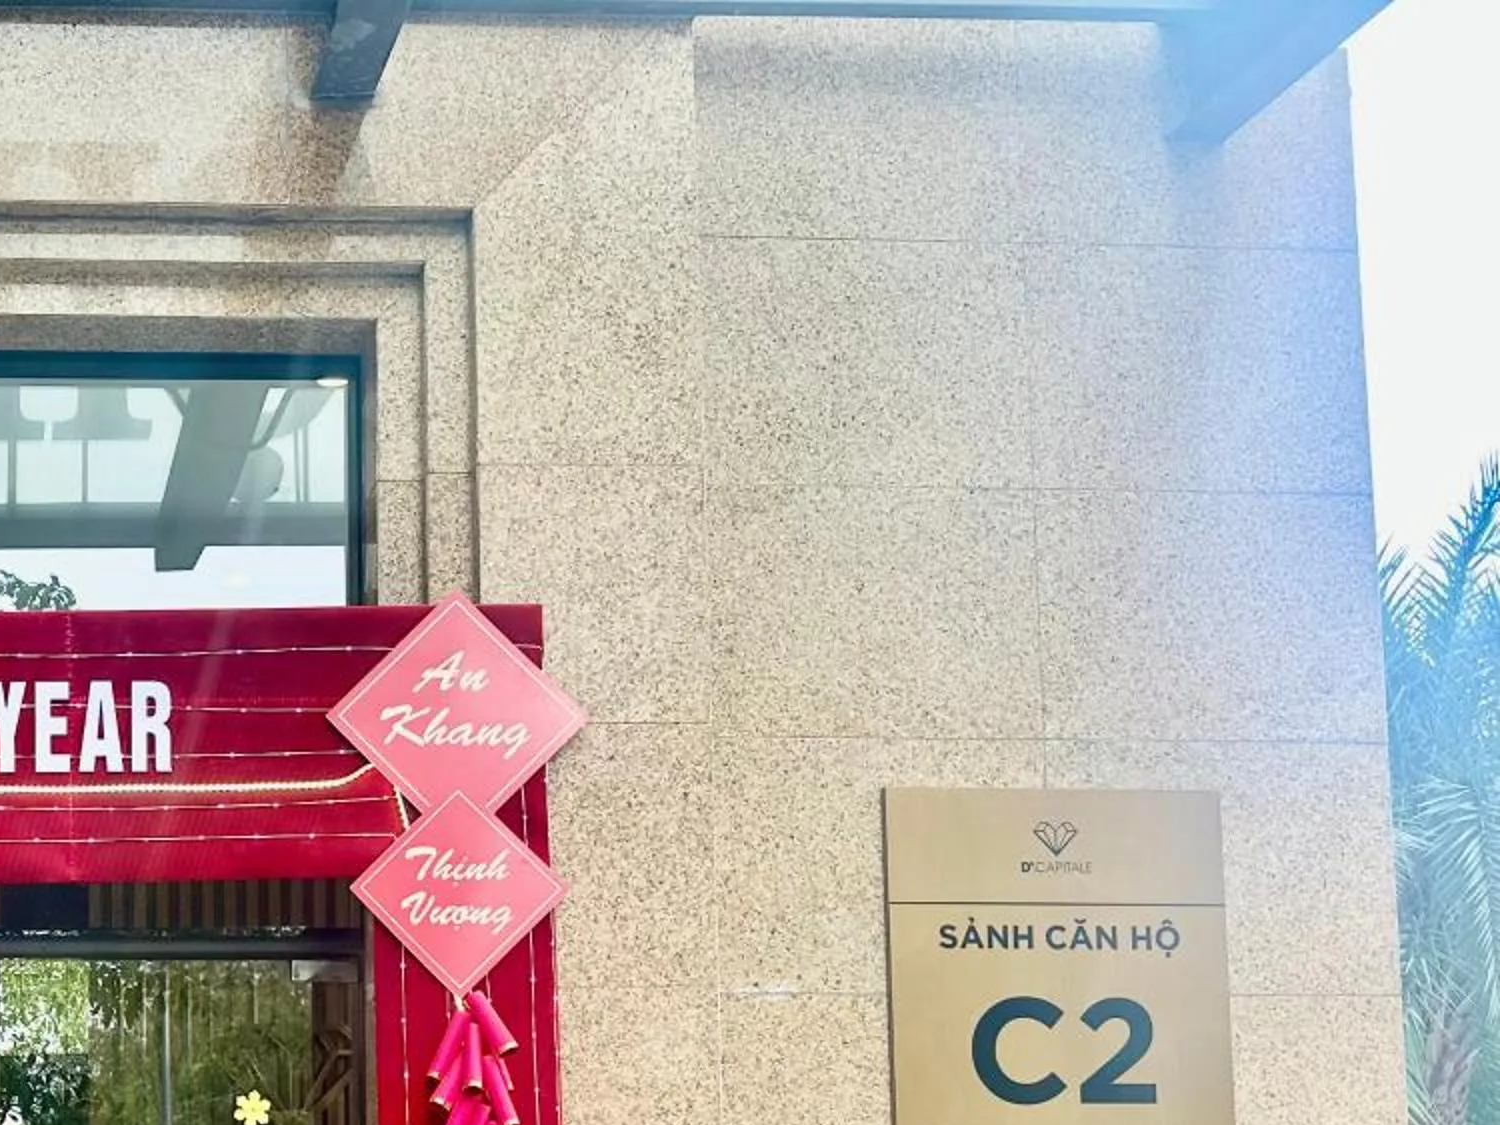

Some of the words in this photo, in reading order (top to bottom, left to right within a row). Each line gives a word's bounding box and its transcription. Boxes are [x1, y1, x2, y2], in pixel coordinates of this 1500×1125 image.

[412, 649, 490, 693] An
[379, 703, 532, 761] Khang
[404, 845, 511, 888] Thịnh
[938, 916, 1034, 950] SẢNH
[1045, 917, 1118, 950] CĂN
[1130, 918, 1180, 959] HỘ
[971, 995, 1157, 1106] C2
